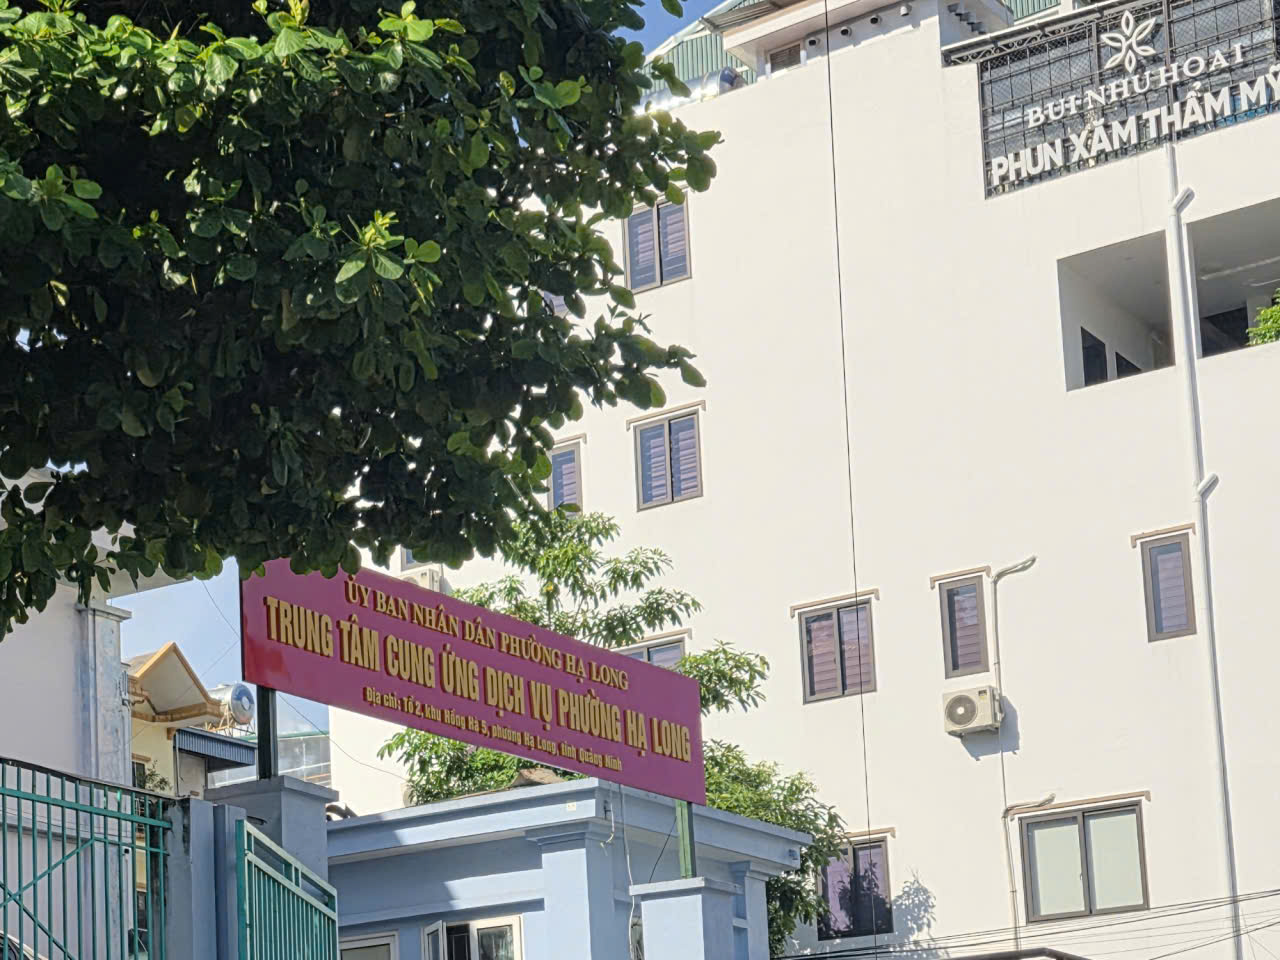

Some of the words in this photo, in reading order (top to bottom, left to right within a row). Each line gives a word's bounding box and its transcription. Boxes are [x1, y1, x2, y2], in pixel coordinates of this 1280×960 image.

[991, 138, 1064, 186] PHUN
[1069, 115, 1138, 163] XĂM
[1142, 81, 1232, 139] THẨM
[264, 594, 334, 658] TRUNG
[338, 612, 381, 672] TÂM
[384, 633, 436, 689] CUNG
[440, 642, 480, 702] ỨNG
[484, 664, 526, 721] DỊCH
[529, 679, 553, 732] VỤ
[556, 687, 622, 743] PHƯỜNG
[623, 708, 648, 757] HẠ
[650, 716, 692, 763] LONG
[346, 574, 372, 608] ỦY
[374, 589, 409, 621] BAN
[410, 602, 459, 638] NHÂN
[462, 615, 497, 650] DÂN
[499, 632, 561, 671] PHƯỜNG
[563, 652, 587, 684] HẠ
[589, 660, 630, 691] LONG
[364, 686, 381, 707] Địa
[424, 702, 442, 722] khu
